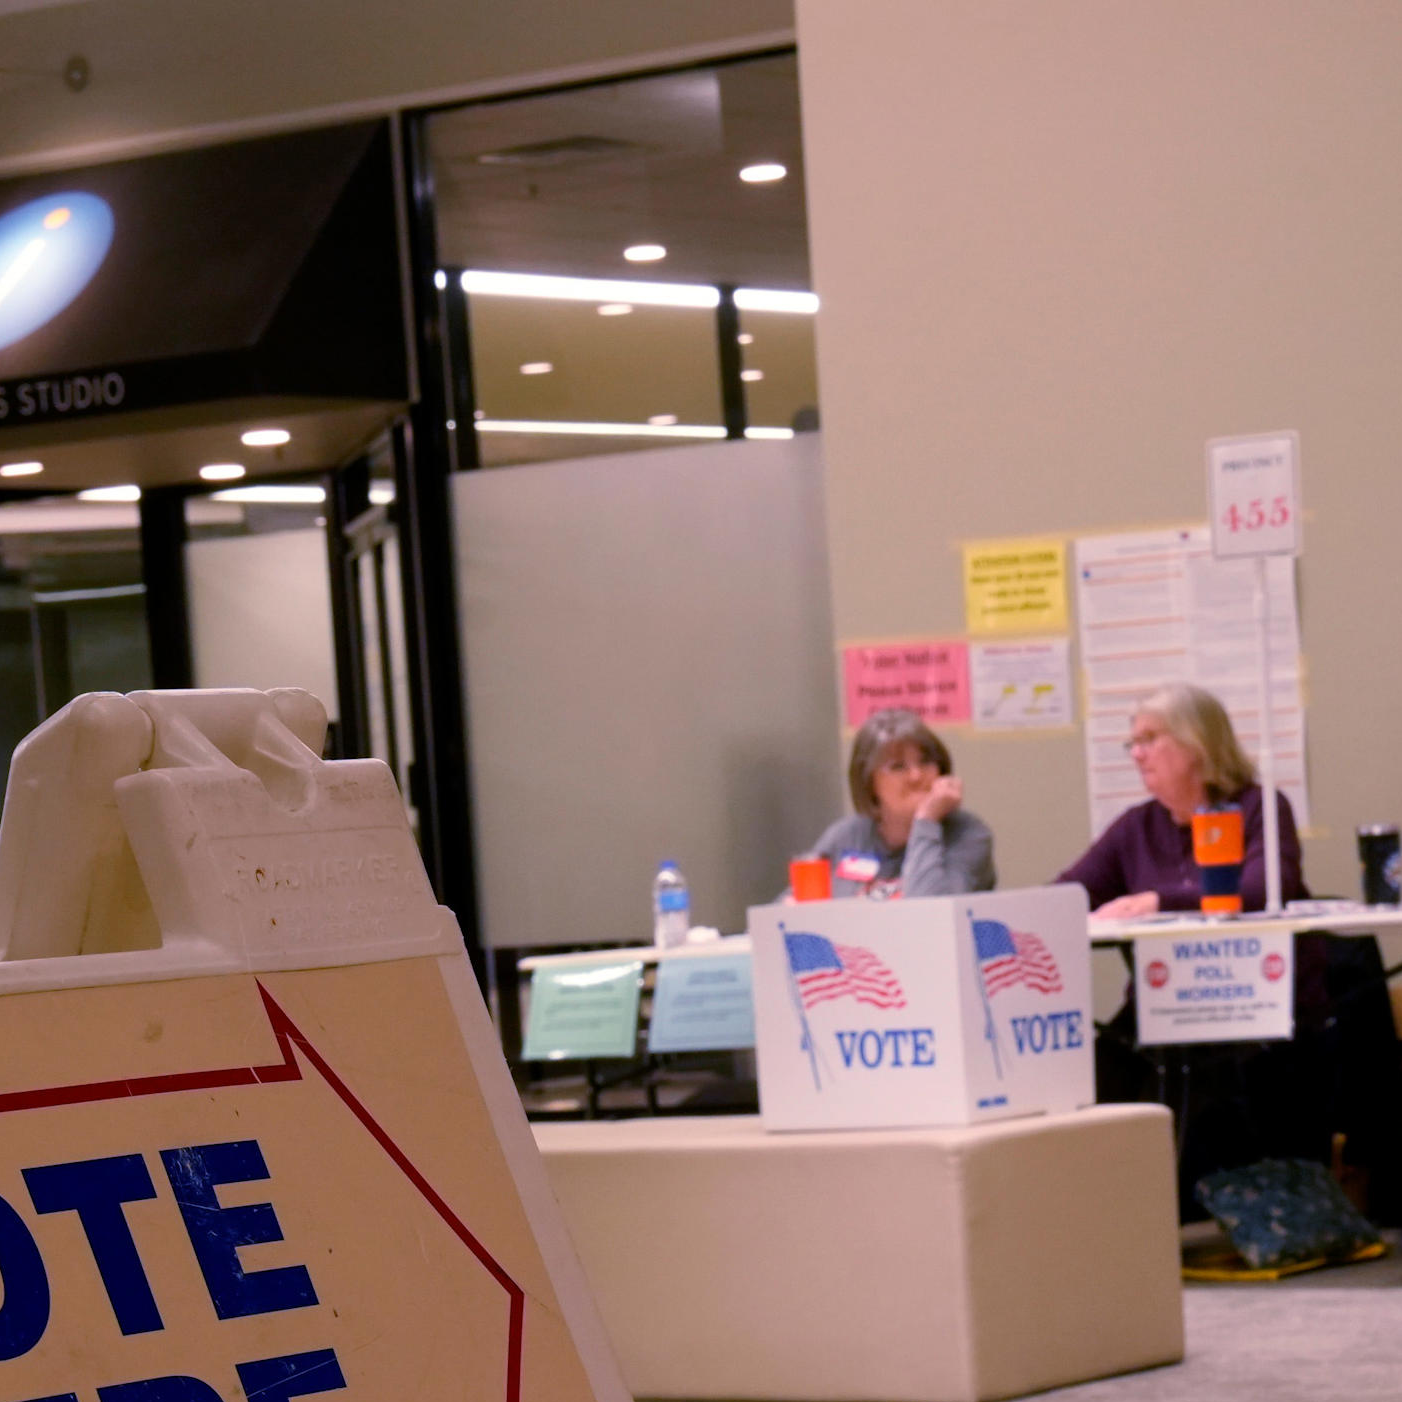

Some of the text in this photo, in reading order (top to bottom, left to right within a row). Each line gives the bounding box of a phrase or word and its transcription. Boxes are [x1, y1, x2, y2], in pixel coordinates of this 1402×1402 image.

[16, 371, 126, 417] STUDIO
[1220, 496, 1291, 532] 455
[1173, 938, 1260, 960] WANTED
[1194, 966, 1234, 980] POLL
[1176, 986, 1254, 1001] WORKERS
[835, 1028, 936, 1069] VOTE
[1010, 1010, 1084, 1055] VOTE
